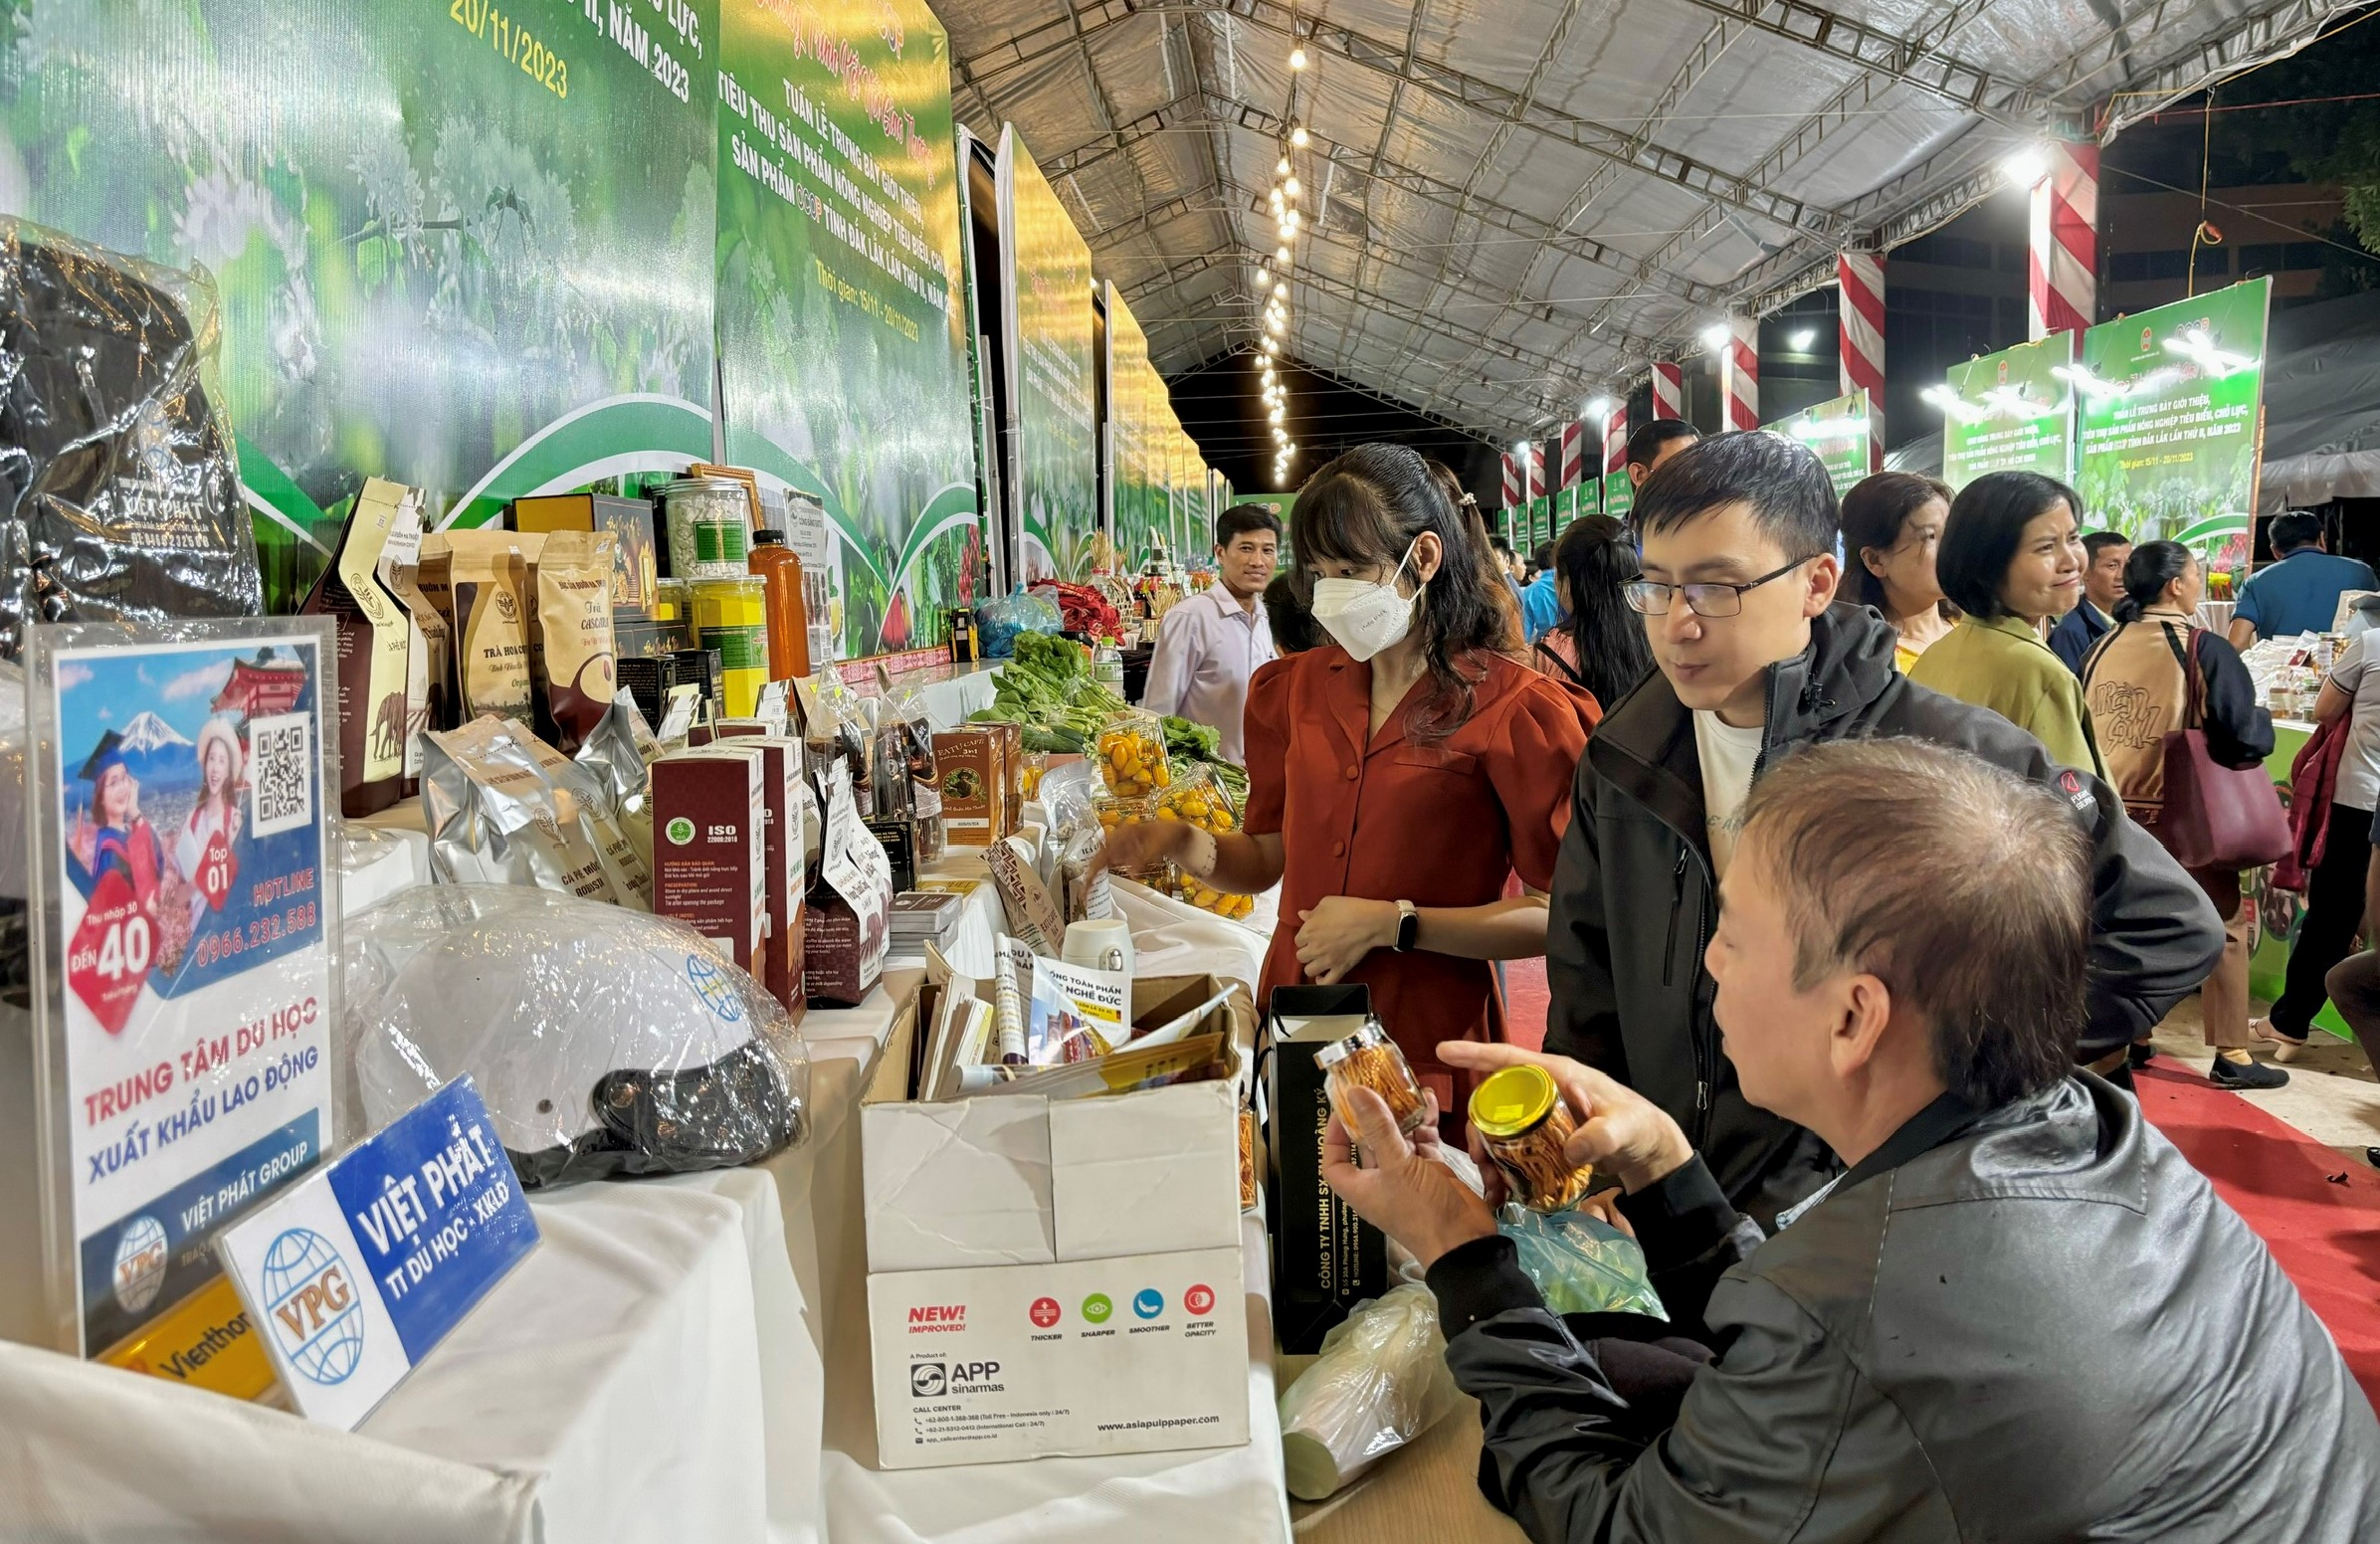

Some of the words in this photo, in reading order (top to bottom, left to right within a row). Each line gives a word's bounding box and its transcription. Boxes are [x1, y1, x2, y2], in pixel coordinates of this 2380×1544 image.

[450, 0, 568, 98] 20/11/2023
[609, 0, 649, 70] NĂM
[653, 43, 690, 103] 2023
[717, 69, 747, 119] TIÊU
[749, 96, 776, 149] THỤ
[778, 117, 802, 164] SẢN
[803, 142, 833, 189] PHẨM
[834, 167, 862, 213] NÔNG
[861, 191, 892, 239] NGHIỆP
[892, 217, 911, 251] TIÊU
[783, 77, 814, 128] TUẦN
[815, 100, 829, 141] LỄ
[829, 122, 863, 172] TRƯNG
[863, 151, 881, 187] BÀY
[881, 170, 899, 204] GIỚI
[899, 185, 924, 230] THIỆU,
[731, 129, 759, 180] SẢN
[761, 155, 796, 206] PHẨM
[796, 182, 823, 224] OCOP
[823, 198, 848, 244] TỈNH
[848, 217, 869, 259] ĐẮK
[868, 233, 887, 271] LẮK
[886, 248, 901, 283] LẦN
[901, 265, 918, 293] THỨ
[927, 283, 944, 311] NĂM
[816, 259, 838, 292] Thời
[838, 277, 859, 306] gian:
[860, 289, 879, 318] 15/11
[885, 303, 919, 343] 20/11/2023
[2159, 400, 2172, 412] BÀY
[2154, 416, 2178, 429] NGHIỆP
[2179, 412, 2195, 424] TIÊU
[2155, 431, 2168, 444] LẮK
[585, 600, 602, 614] Trà
[581, 617, 610, 630] CASCARA
[484, 645, 502, 659] TRÀ
[503, 646, 517, 657] HOA
[937, 742, 963, 757] EATU
[707, 825, 736, 836] ISO
[209, 846, 228, 863] Top
[207, 867, 229, 892] 01
[254, 868, 314, 907] HOTLINE
[87, 914, 102, 926] Thu
[103, 906, 126, 922] nhập
[126, 900, 138, 915] 30
[198, 901, 316, 969] 0966.232.588
[71, 944, 98, 974] ĐẾN
[97, 915, 151, 981] 40
[1070, 976, 1093, 989] TOÀN
[1095, 985, 1122, 995] PHẦN
[1066, 986, 1095, 1000] NGHỀ
[1097, 995, 1122, 1006] ĐỨC
[85, 1061, 174, 1127] TRUNG
[181, 1037, 231, 1082] TÂM
[236, 1019, 266, 1058] DU
[272, 996, 319, 1042] HỌC
[1313, 1087, 1327, 1104] KÝ
[88, 1119, 151, 1185] XUẤT
[157, 1088, 216, 1149] KHẨU
[222, 1075, 260, 1115] LAO
[265, 1045, 319, 1093] ĐỘNG
[181, 1193, 215, 1233] VIỆT
[217, 1170, 256, 1212] PHÁT
[259, 1139, 308, 1185] GROUP
[356, 1175, 428, 1256] VIỆT
[421, 1116, 496, 1210] PHÁT
[1318, 1179, 1329, 1196] SX
[1318, 1198, 1329, 1232] TNHH
[1319, 1235, 1330, 1249] TY
[118, 1241, 165, 1285] VPG
[385, 1269, 409, 1301] TT
[406, 1247, 434, 1285] DU
[432, 1218, 470, 1257] HỌC
[1318, 1252, 1331, 1288] CÔNG
[276, 1263, 351, 1343] VPG
[908, 1305, 966, 1323] NEW!
[908, 1323, 966, 1334] IMPROVED!
[1081, 1329, 1115, 1338] SHARPER
[1129, 1325, 1170, 1334] SMOOTHER
[1184, 1329, 1216, 1338] OPACITY
[951, 1361, 1000, 1383] APP
[951, 1382, 1005, 1394] sinarmas
[980, 1413, 992, 1422] (Toll
[1097, 1415, 1220, 1432] www.asiapulppaper.com
